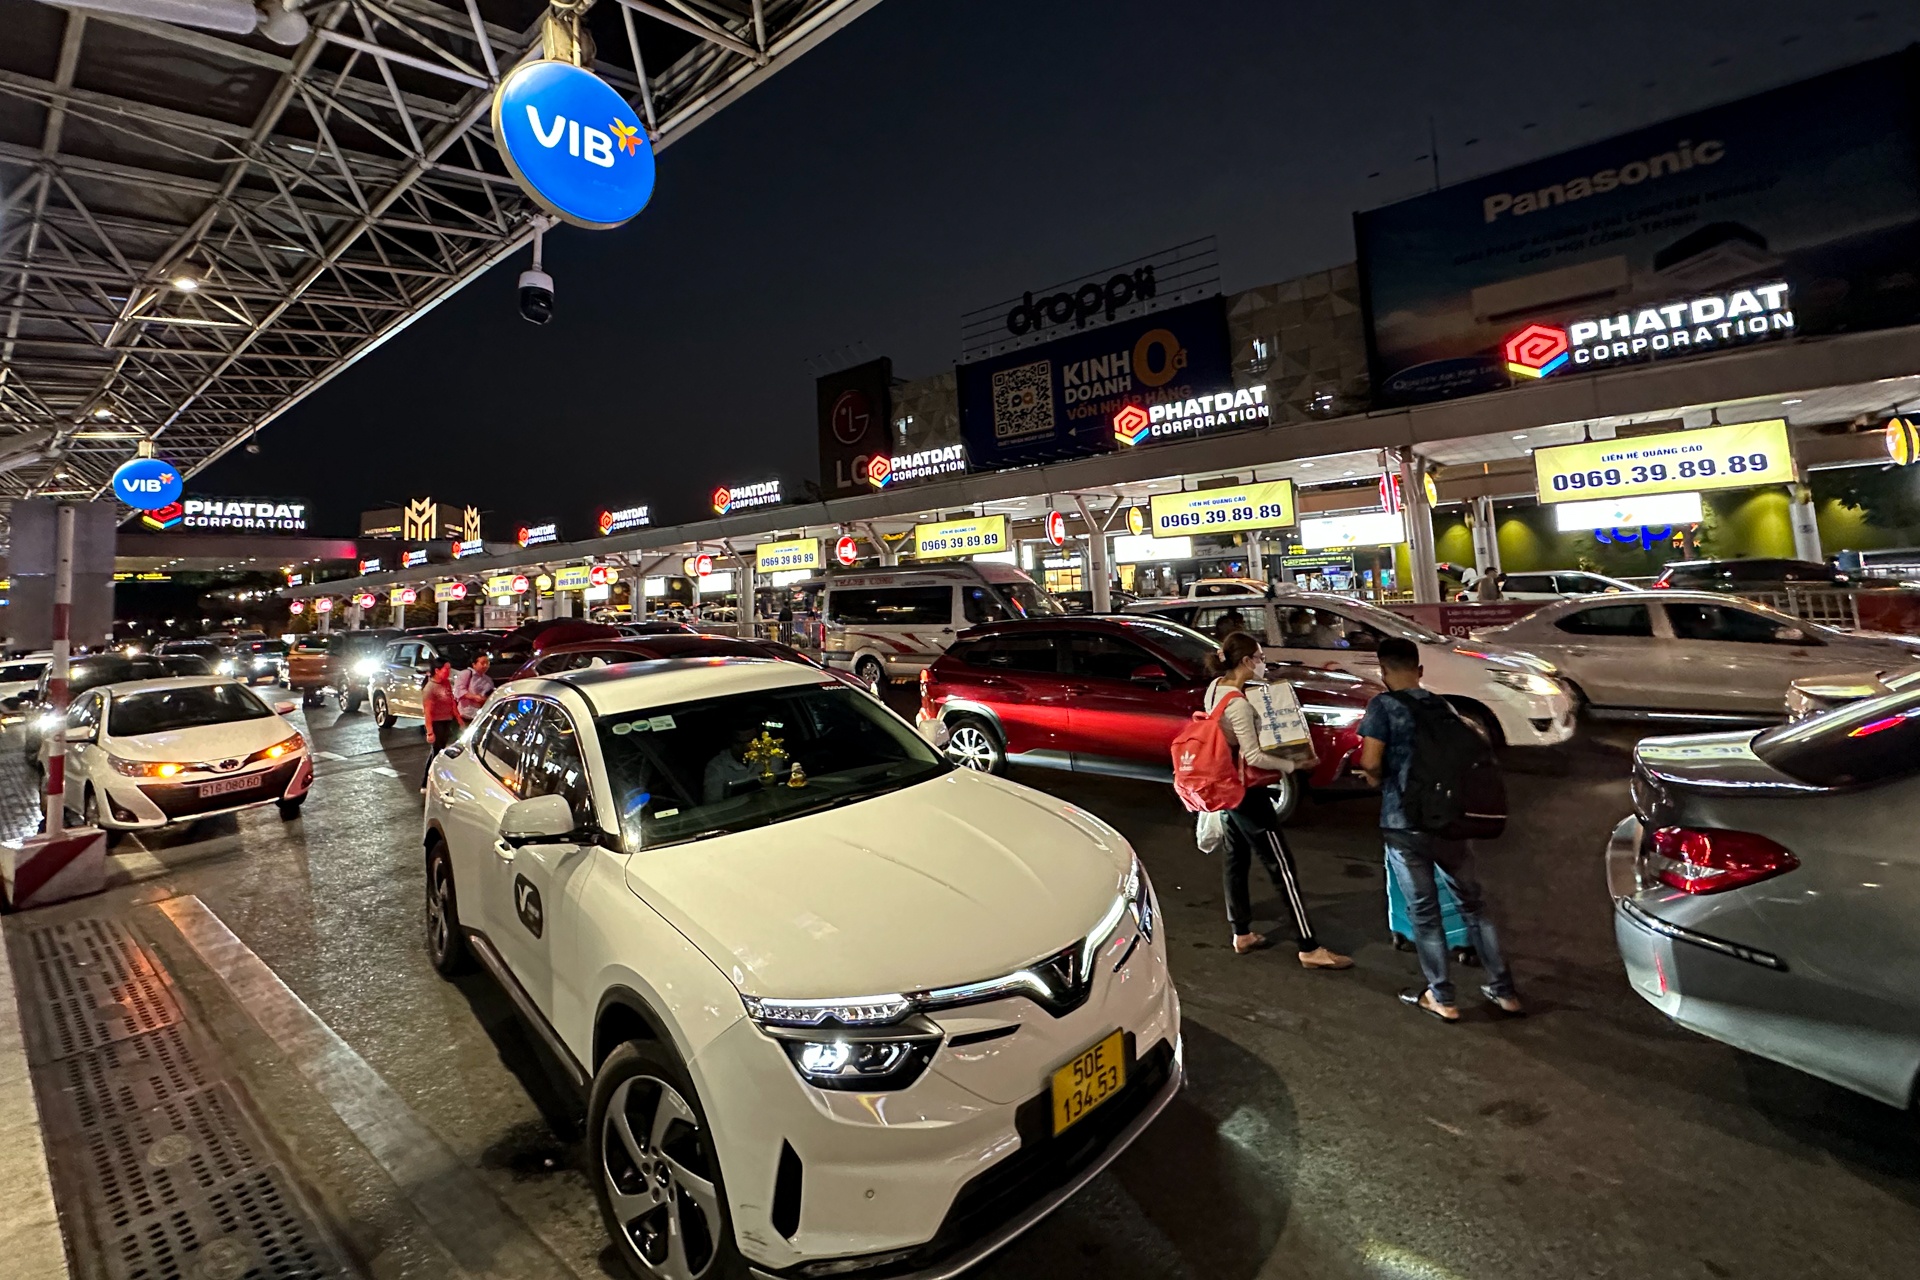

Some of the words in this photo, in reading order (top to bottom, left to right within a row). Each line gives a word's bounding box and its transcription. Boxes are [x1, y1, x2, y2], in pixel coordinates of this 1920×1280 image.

[525, 104, 615, 168] VIB
[1482, 137, 1726, 224] Panasonic
[1571, 282, 1790, 346] PHATDAT
[1574, 311, 1795, 364] CORPORATION
[1062, 349, 1131, 388] KINH
[1064, 375, 1133, 405] DOANH
[1148, 384, 1267, 424] PHATDAT
[1151, 405, 1270, 437] CORPORATION
[890, 445, 964, 471] PHATDAT
[891, 459, 965, 482] CORPORATION
[1552, 452, 1769, 492] 0969.39.89.89
[122, 479, 162, 493] VIB
[730, 480, 779, 500] PHATDAT
[184, 500, 305, 518] PHATDAT
[612, 506, 648, 521] PHATDAT
[731, 494, 781, 510] CORPORATION
[1161, 503, 1282, 528] 0969.39.89.89
[184, 516, 306, 530] CORPORATION
[921, 533, 998, 551] 0969.39.89.89
[1672, 540, 1702, 548] PAK
[1072, 1045, 1104, 1086] 50E
[1063, 1065, 1117, 1123] 134.53
